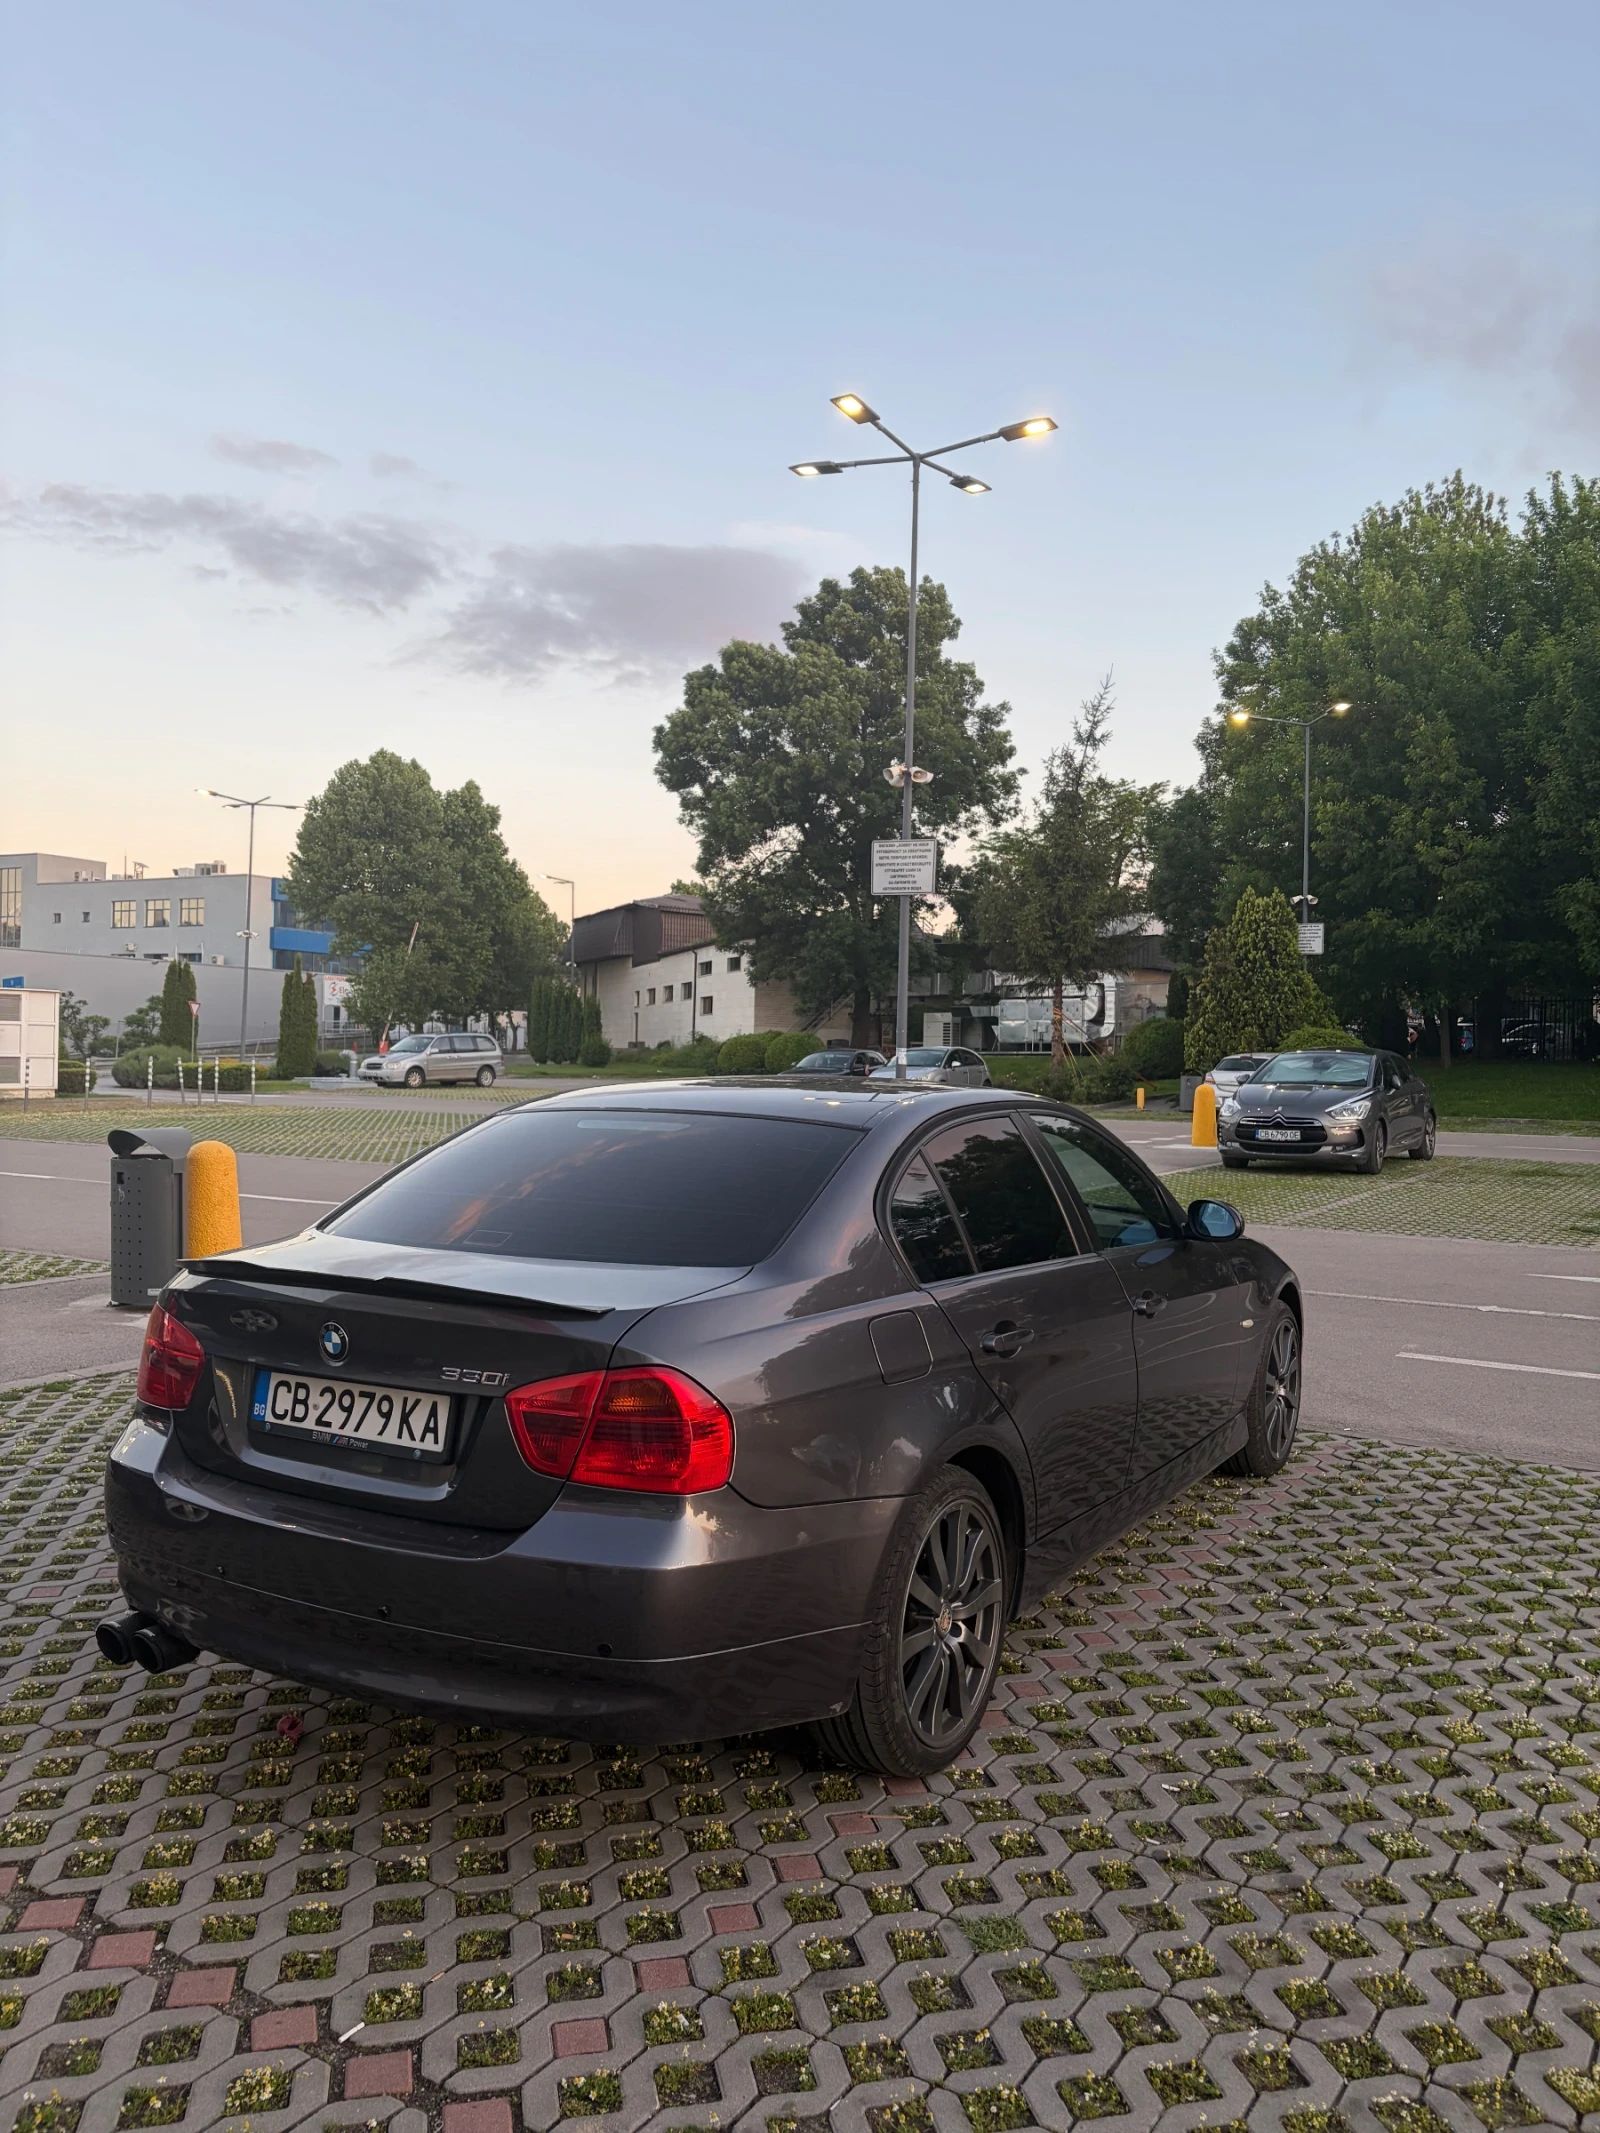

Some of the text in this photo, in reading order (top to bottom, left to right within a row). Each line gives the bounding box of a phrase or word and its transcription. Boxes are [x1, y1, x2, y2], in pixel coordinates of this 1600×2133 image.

[440, 1366, 511, 1387] 330i
[253, 1402, 266, 1416] BG
[312, 1430, 332, 1443] BMW
